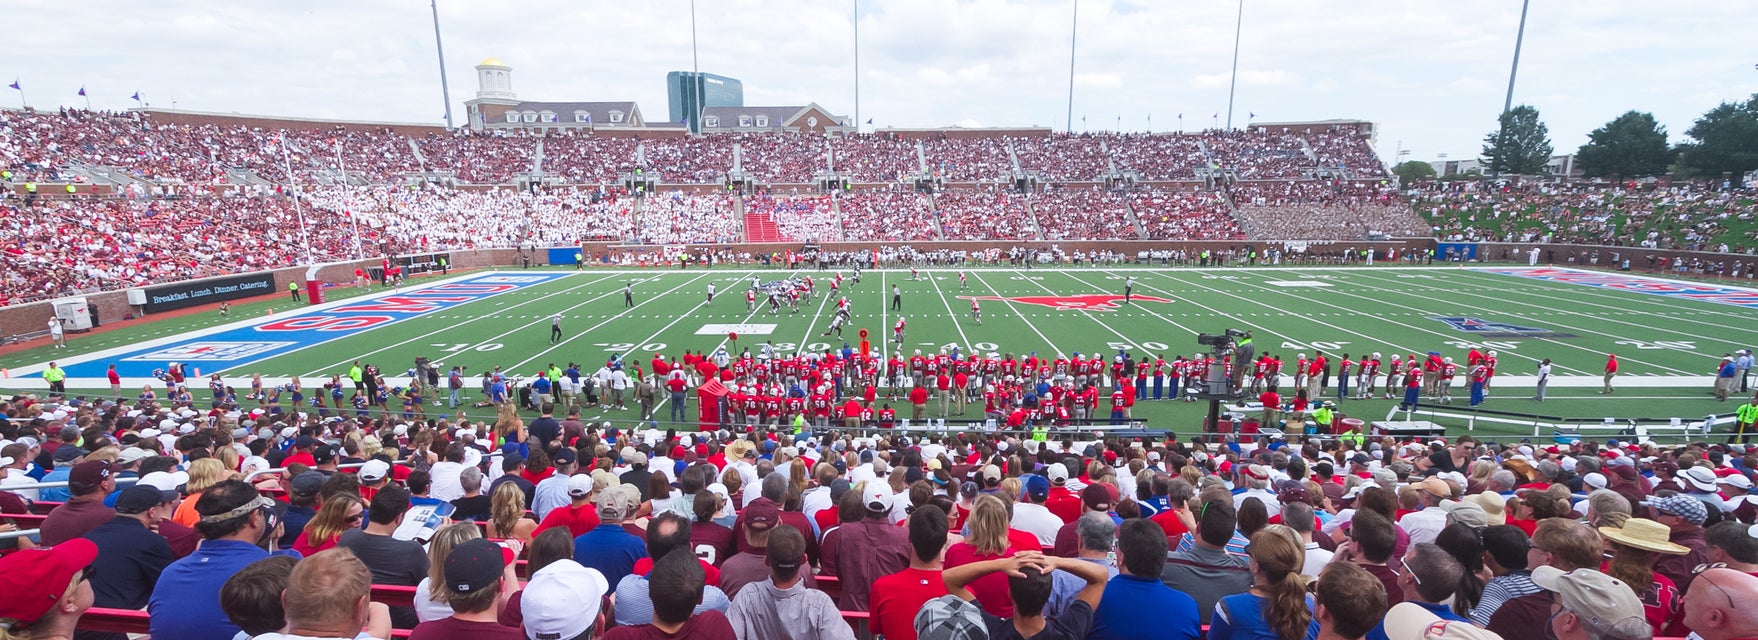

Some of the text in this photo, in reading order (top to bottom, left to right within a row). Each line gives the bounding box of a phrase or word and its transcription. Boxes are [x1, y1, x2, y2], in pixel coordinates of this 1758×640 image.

[153, 280, 270, 304] Breakfast. Lunch. Dinner. Catering.
[1107, 341, 1169, 351] 50
[766, 402, 778, 410] 79
